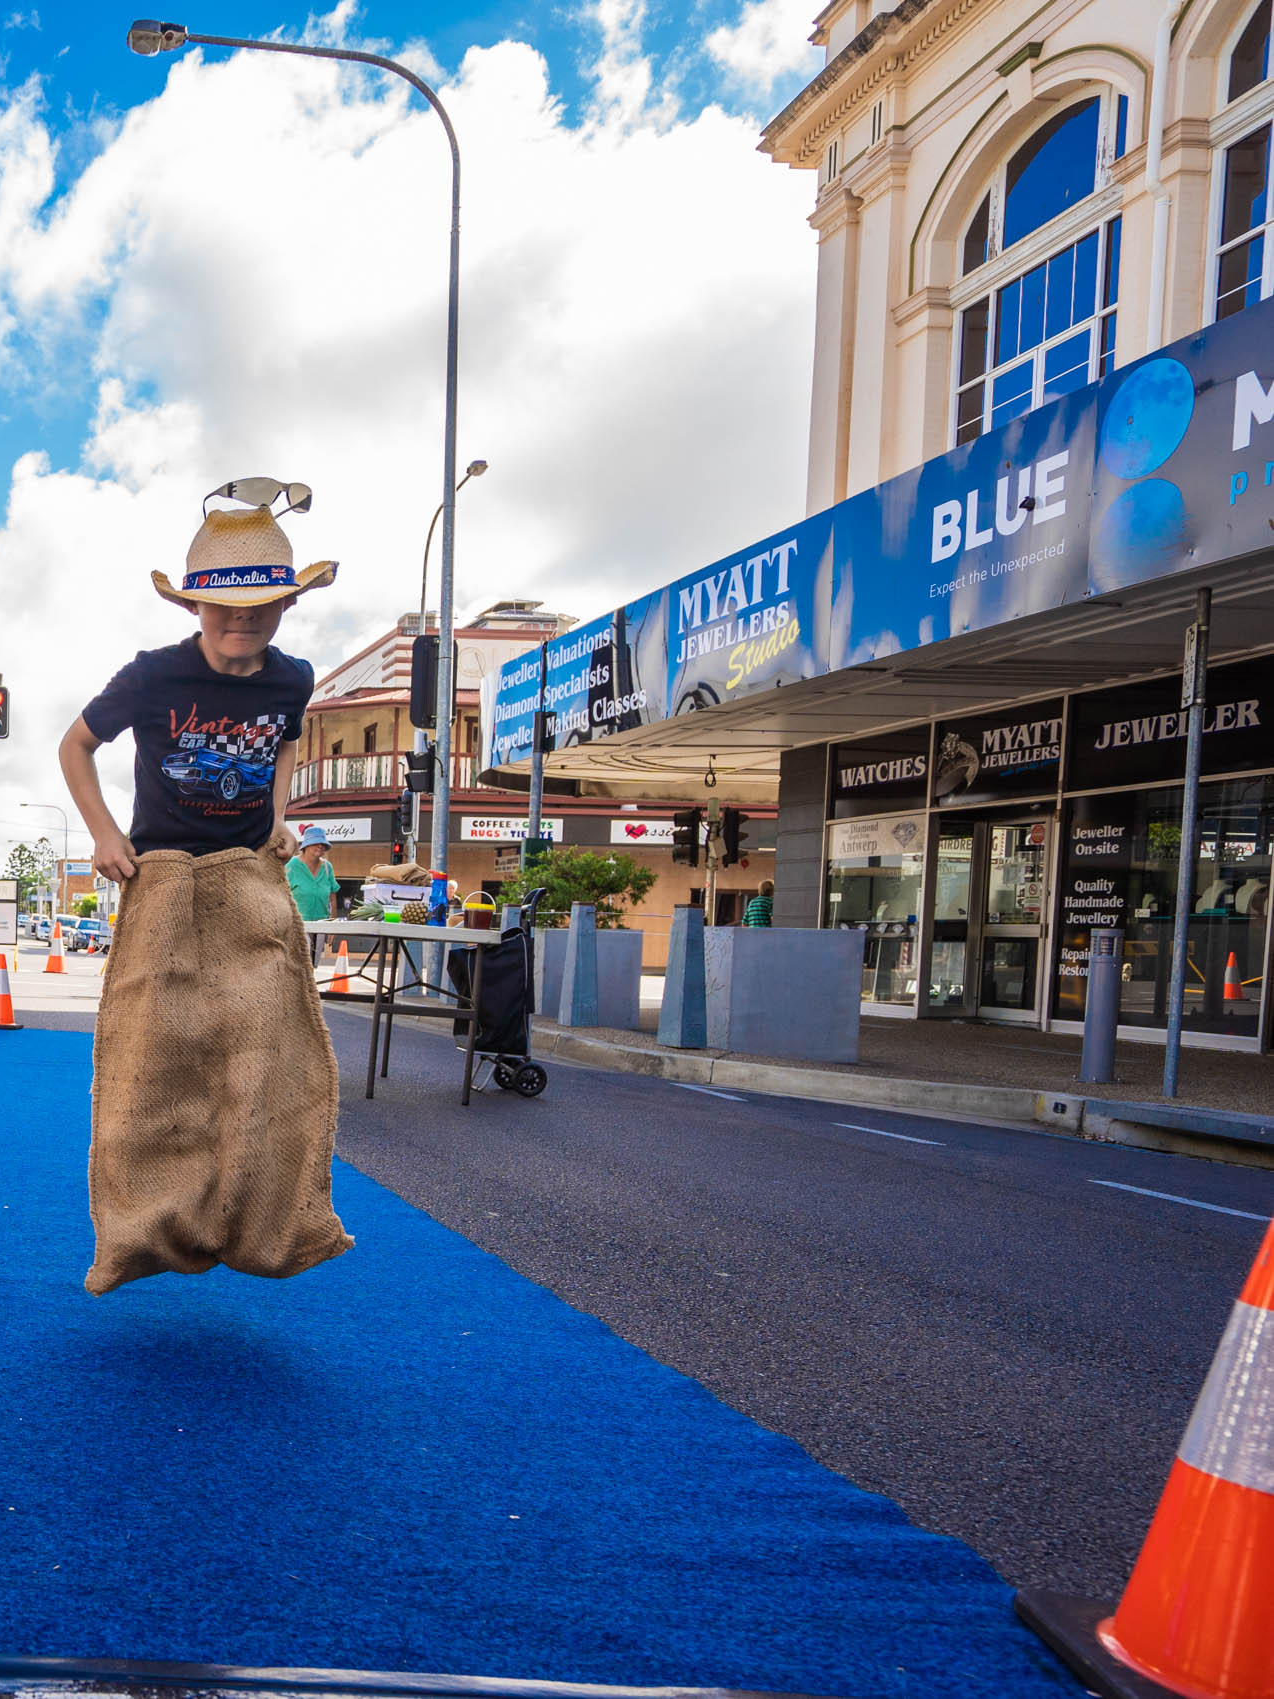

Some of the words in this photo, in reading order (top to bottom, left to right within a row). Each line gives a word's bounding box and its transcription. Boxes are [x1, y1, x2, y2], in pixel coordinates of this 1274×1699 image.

[931, 449, 1069, 564] BLUE
[209, 572, 270, 586] Australia
[929, 576, 966, 598] Expect
[969, 566, 988, 585] the
[990, 539, 1065, 579] Unexpected
[678, 538, 798, 634] MYATT
[676, 601, 790, 663] JEWELLERS
[496, 660, 542, 694] Jewellery
[546, 628, 610, 672] Valuations
[726, 618, 800, 690] Studio
[495, 688, 540, 724] Diamond
[544, 664, 610, 707] Specialists
[170, 703, 277, 746] Vintage
[494, 726, 534, 752] Jeweller
[546, 708, 590, 738] Making
[592, 688, 647, 722] Classes
[982, 718, 1063, 754] MYATT
[982, 745, 1060, 768] JEWELLERS
[840, 755, 927, 788] WATCHES
[470, 830, 500, 838] RUGS
[510, 830, 527, 839] TIE
[472, 820, 512, 828] COFFEE
[522, 820, 554, 829] GTS
[850, 822, 878, 833] Diamond
[1072, 826, 1124, 840] Jeweller
[840, 840, 878, 855] Antwerp
[1076, 842, 1120, 855] On-site
[1074, 880, 1114, 894] Quality
[1064, 896, 1124, 909] Handmade
[1066, 912, 1118, 927] Jewellery
